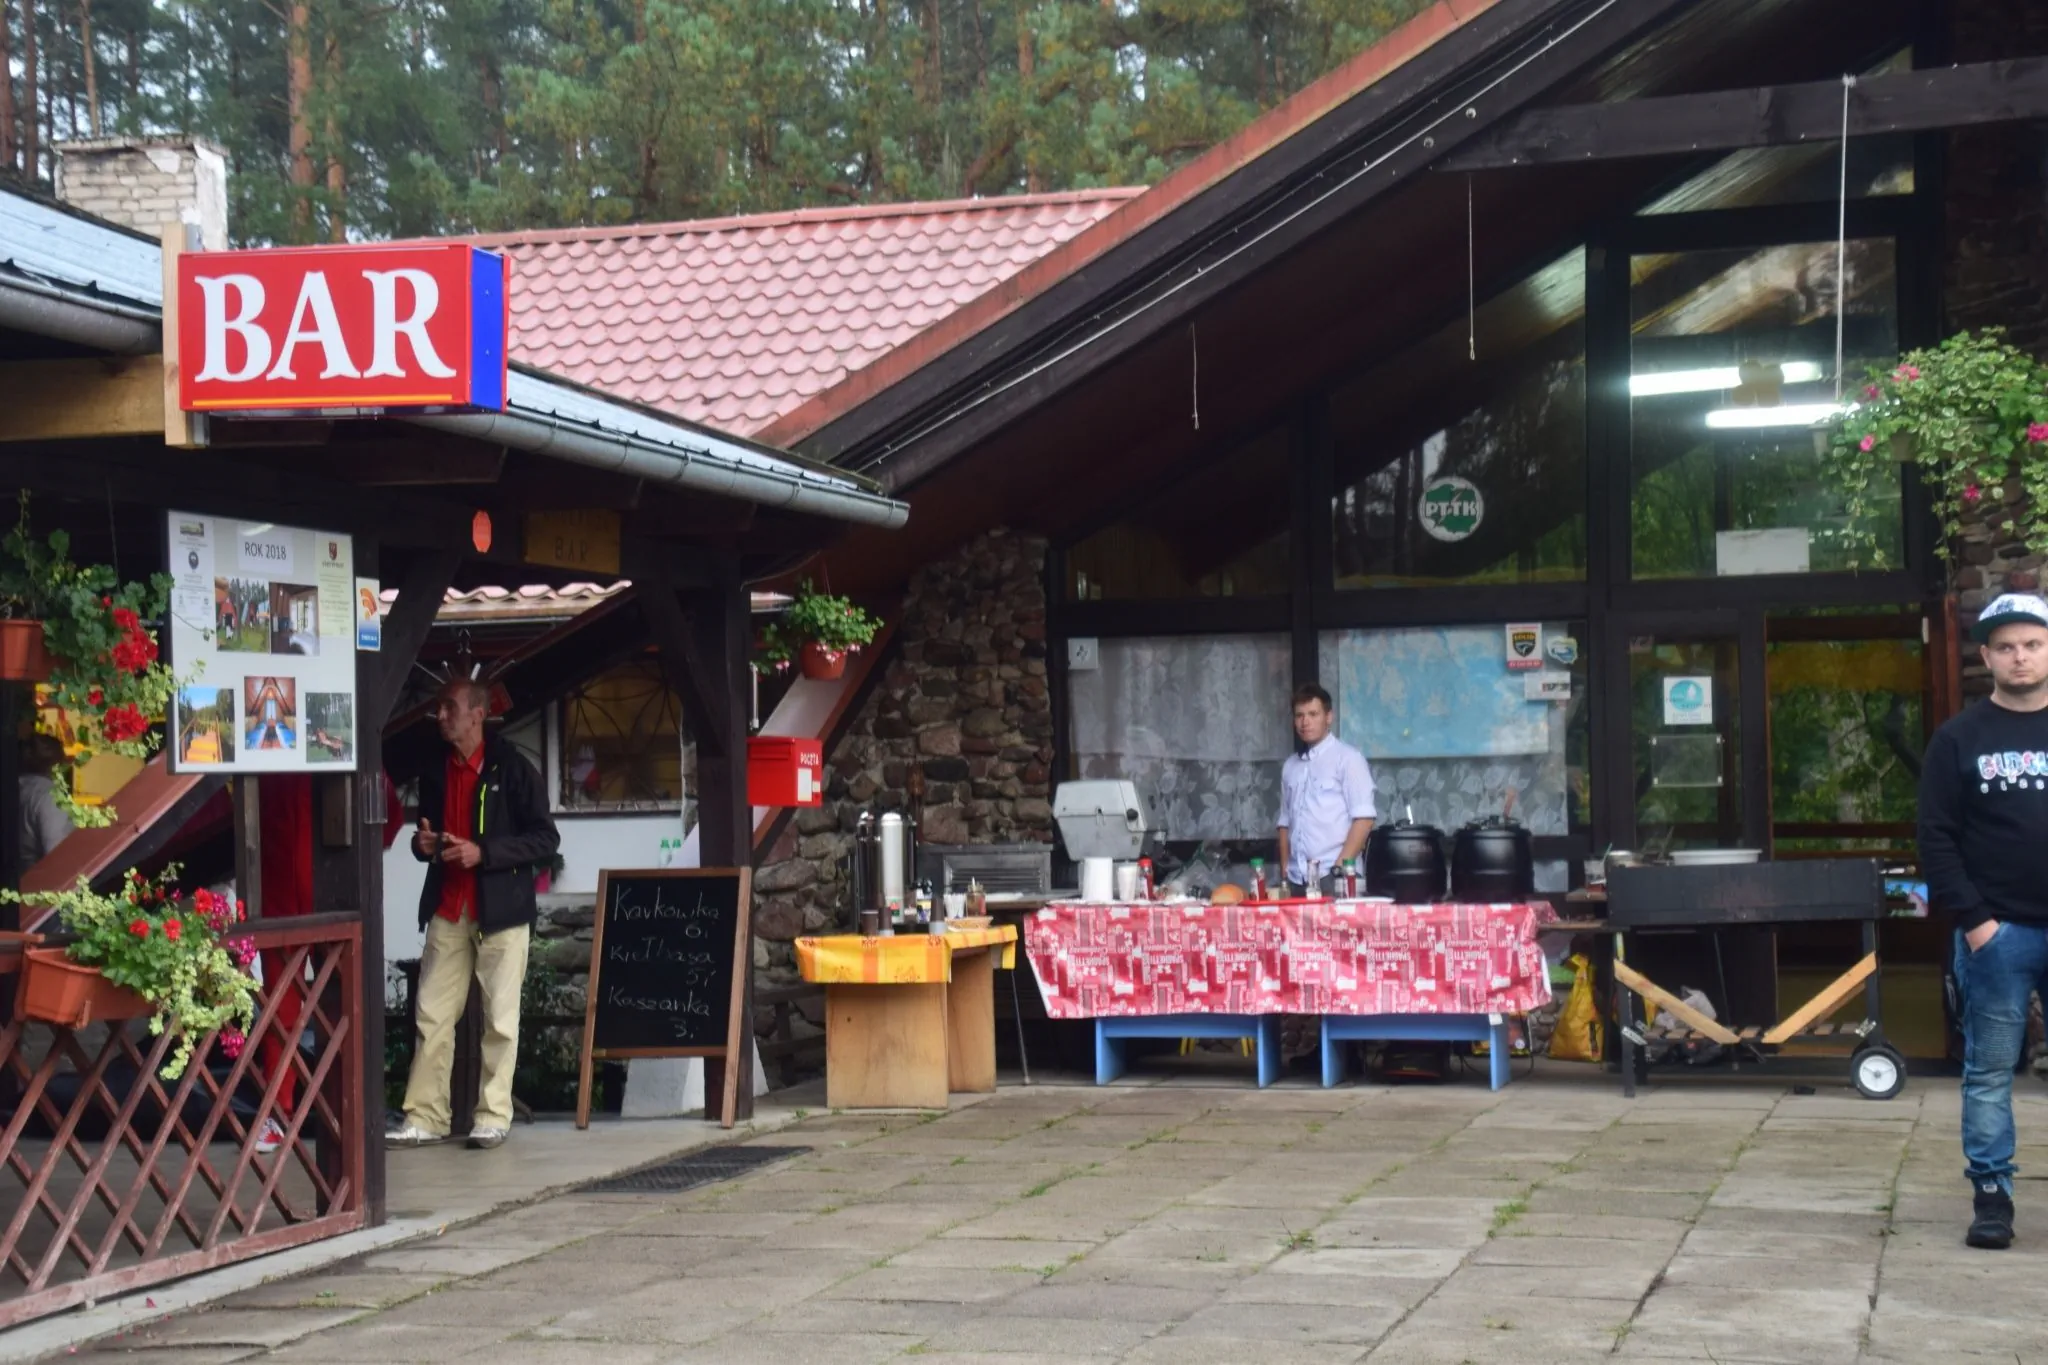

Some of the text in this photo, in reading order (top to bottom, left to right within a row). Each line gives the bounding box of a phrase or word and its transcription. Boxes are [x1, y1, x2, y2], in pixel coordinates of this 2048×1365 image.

[194, 268, 457, 383] BAR
[1425, 501, 1477, 517] PTTK
[244, 542, 287, 561] ROK 2018
[555, 536, 588, 563] BAR
[608, 985, 711, 1017] Kaszanka
